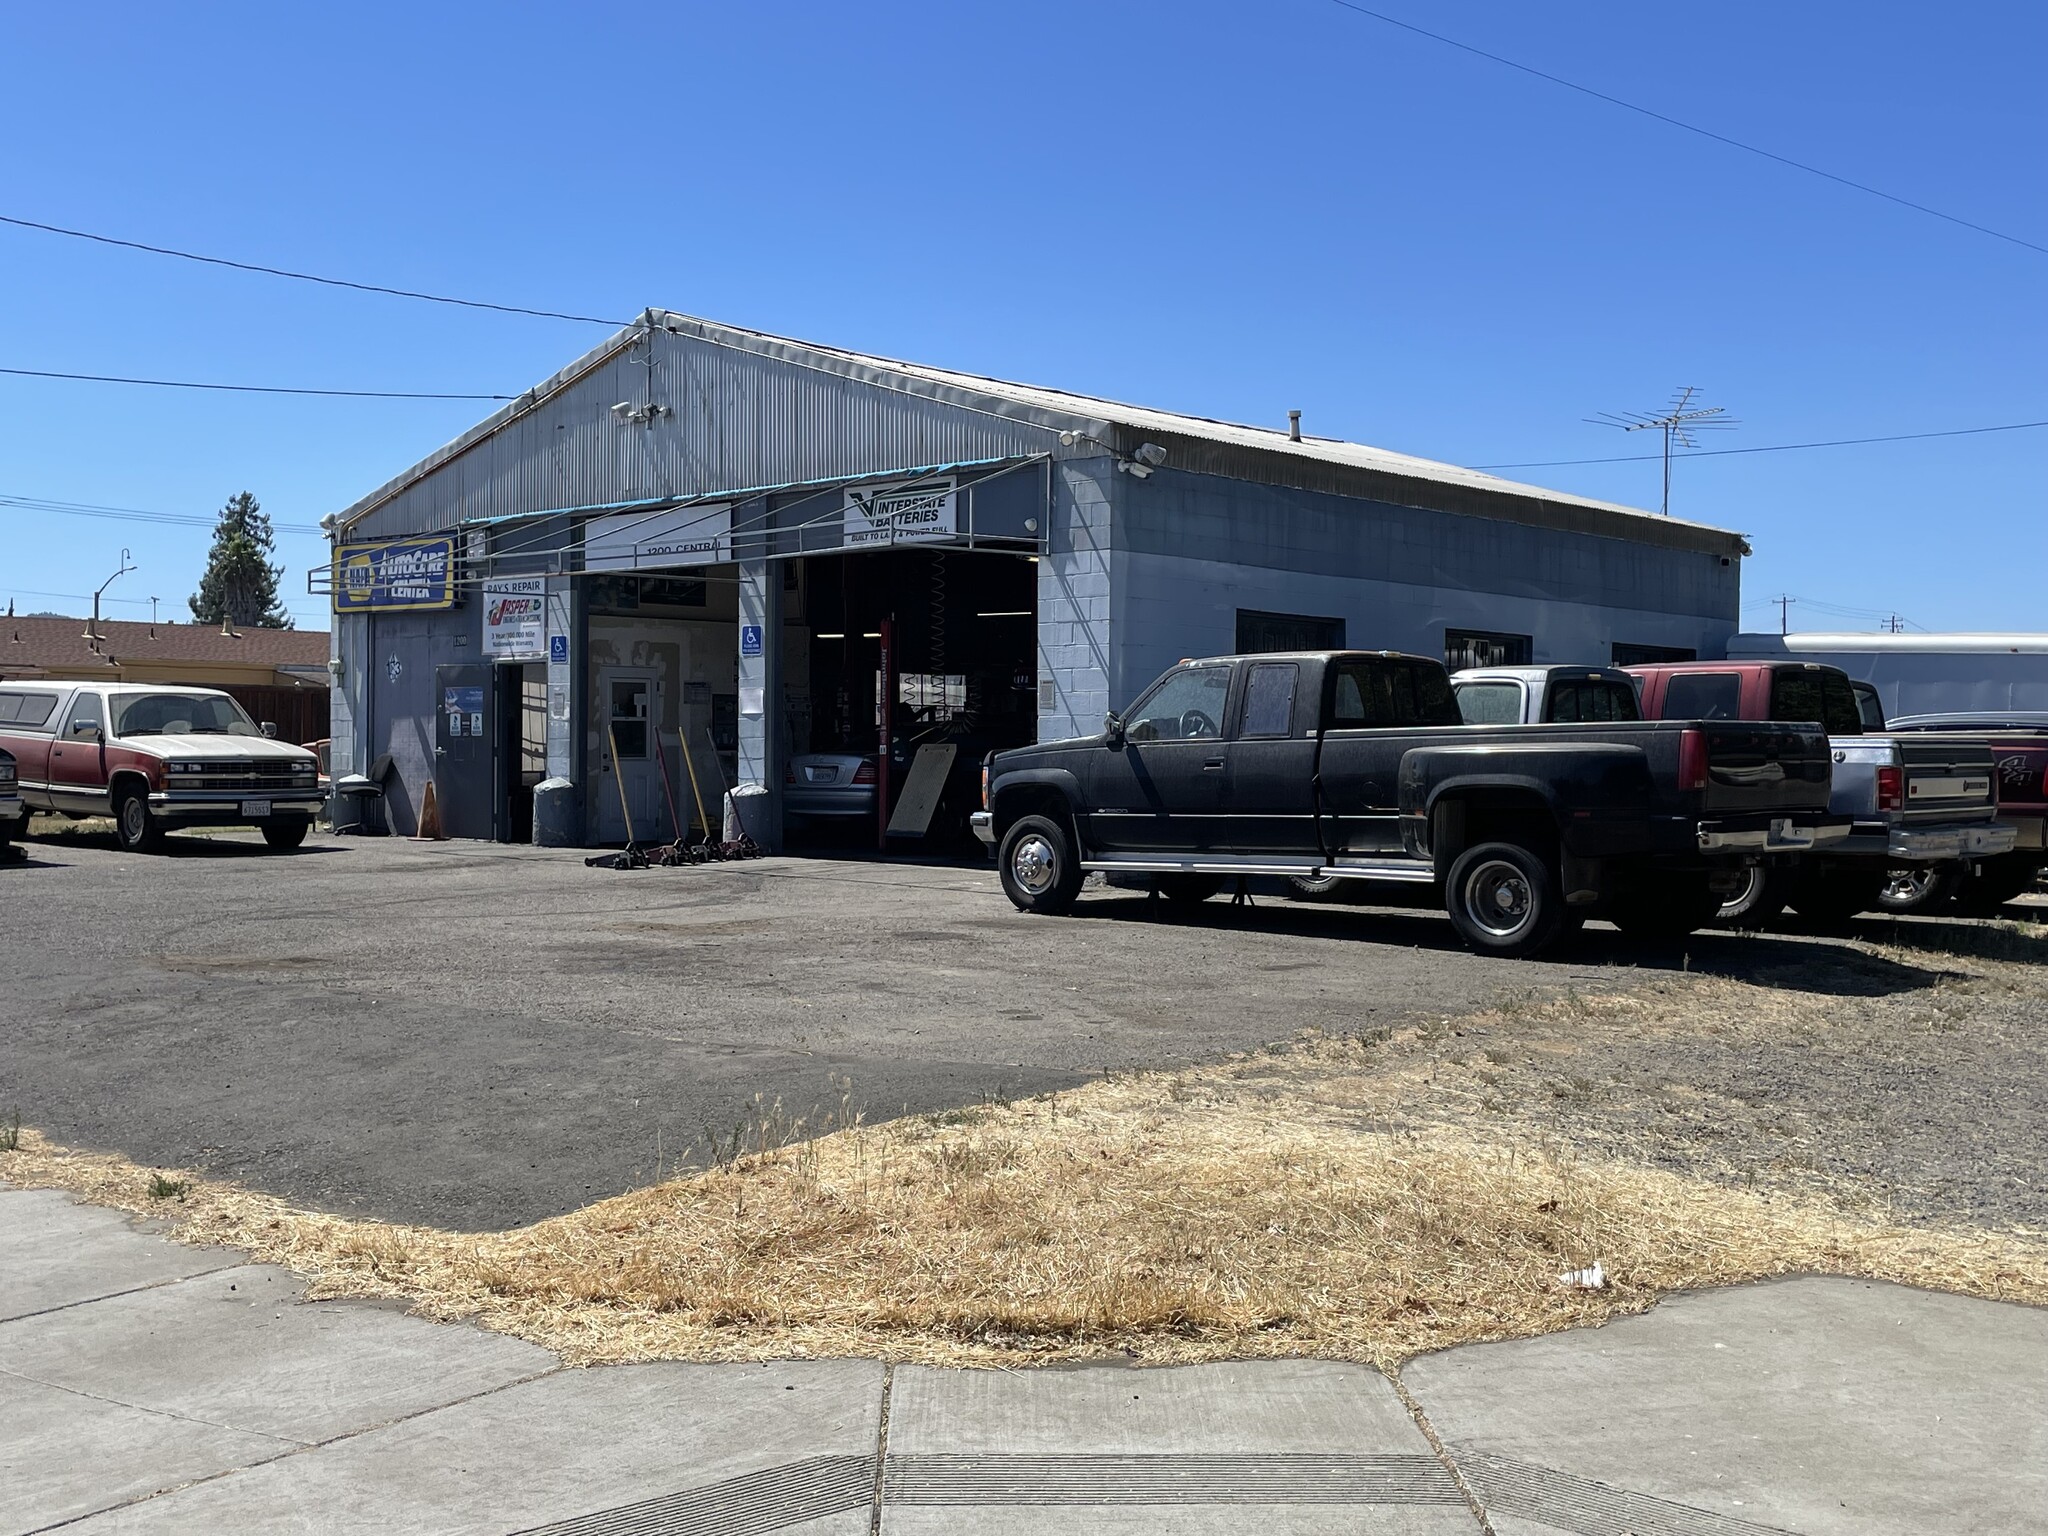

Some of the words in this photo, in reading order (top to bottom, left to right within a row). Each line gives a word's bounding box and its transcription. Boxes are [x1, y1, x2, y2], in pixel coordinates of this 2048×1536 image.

[878, 496, 946, 514] INTERSTATE
[876, 510, 938, 527] BATERIES
[851, 533, 868, 542] BUILT
[880, 531, 897, 539] LAT
[647, 547, 672, 555] 1200
[512, 581, 541, 592] REPAIR
[490, 599, 530, 626] JASPER
